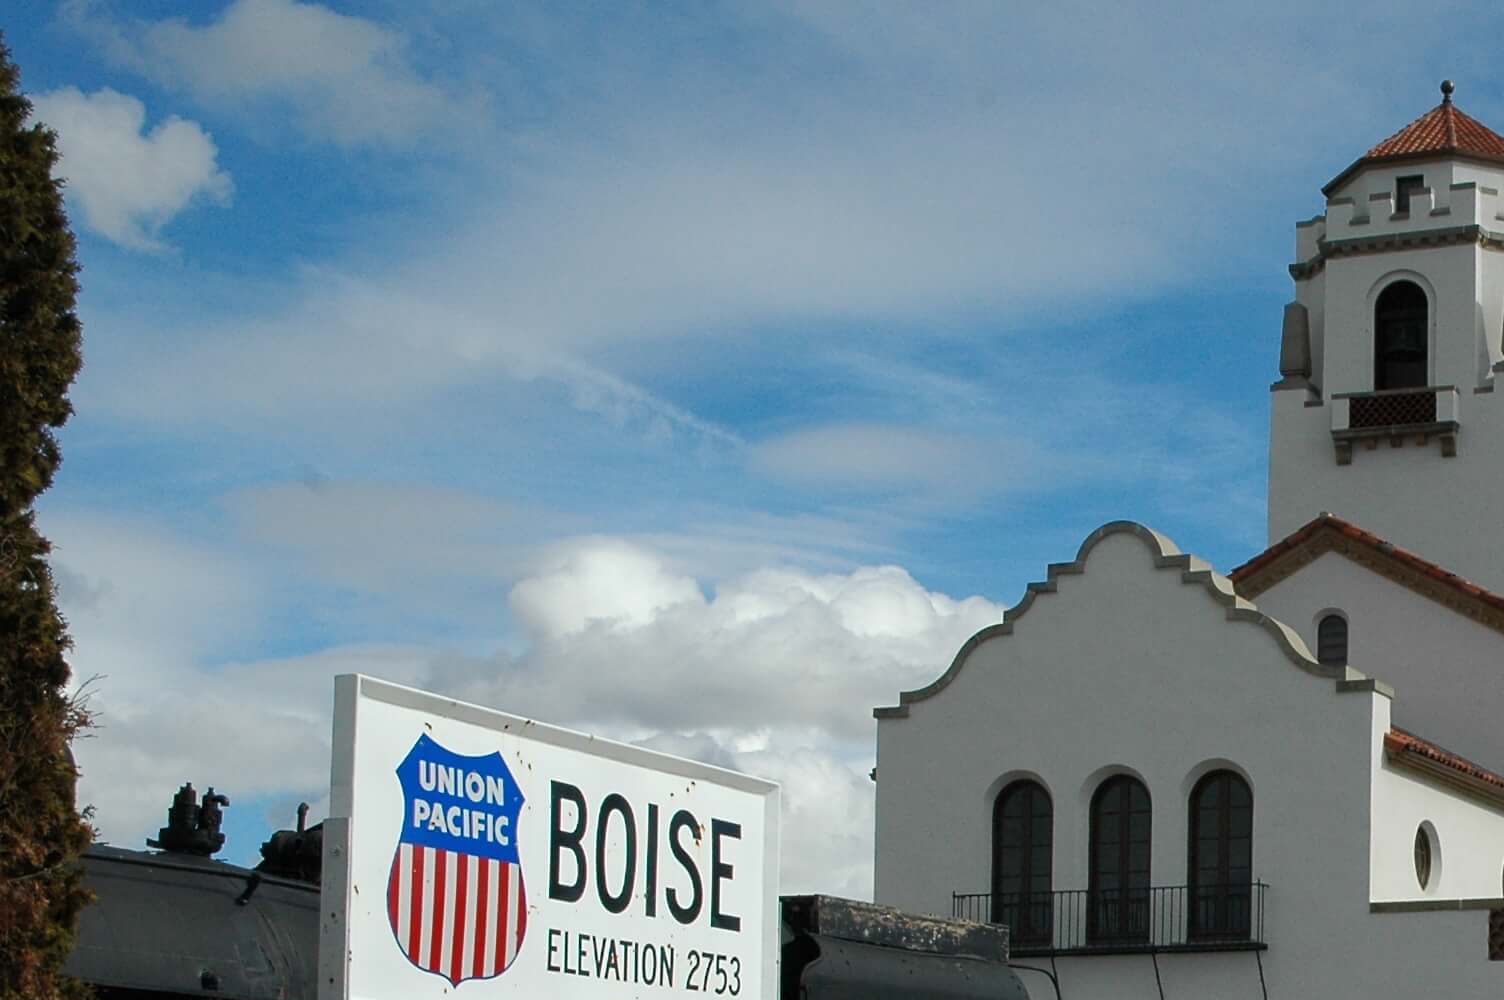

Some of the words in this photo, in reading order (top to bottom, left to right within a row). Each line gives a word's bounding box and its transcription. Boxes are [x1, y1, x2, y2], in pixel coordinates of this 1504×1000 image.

[419, 760, 504, 806] UNION
[413, 798, 509, 846] PACIFIC
[549, 780, 742, 932] BOISE
[547, 928, 674, 987] ELEVATION
[686, 950, 741, 996] 2753
